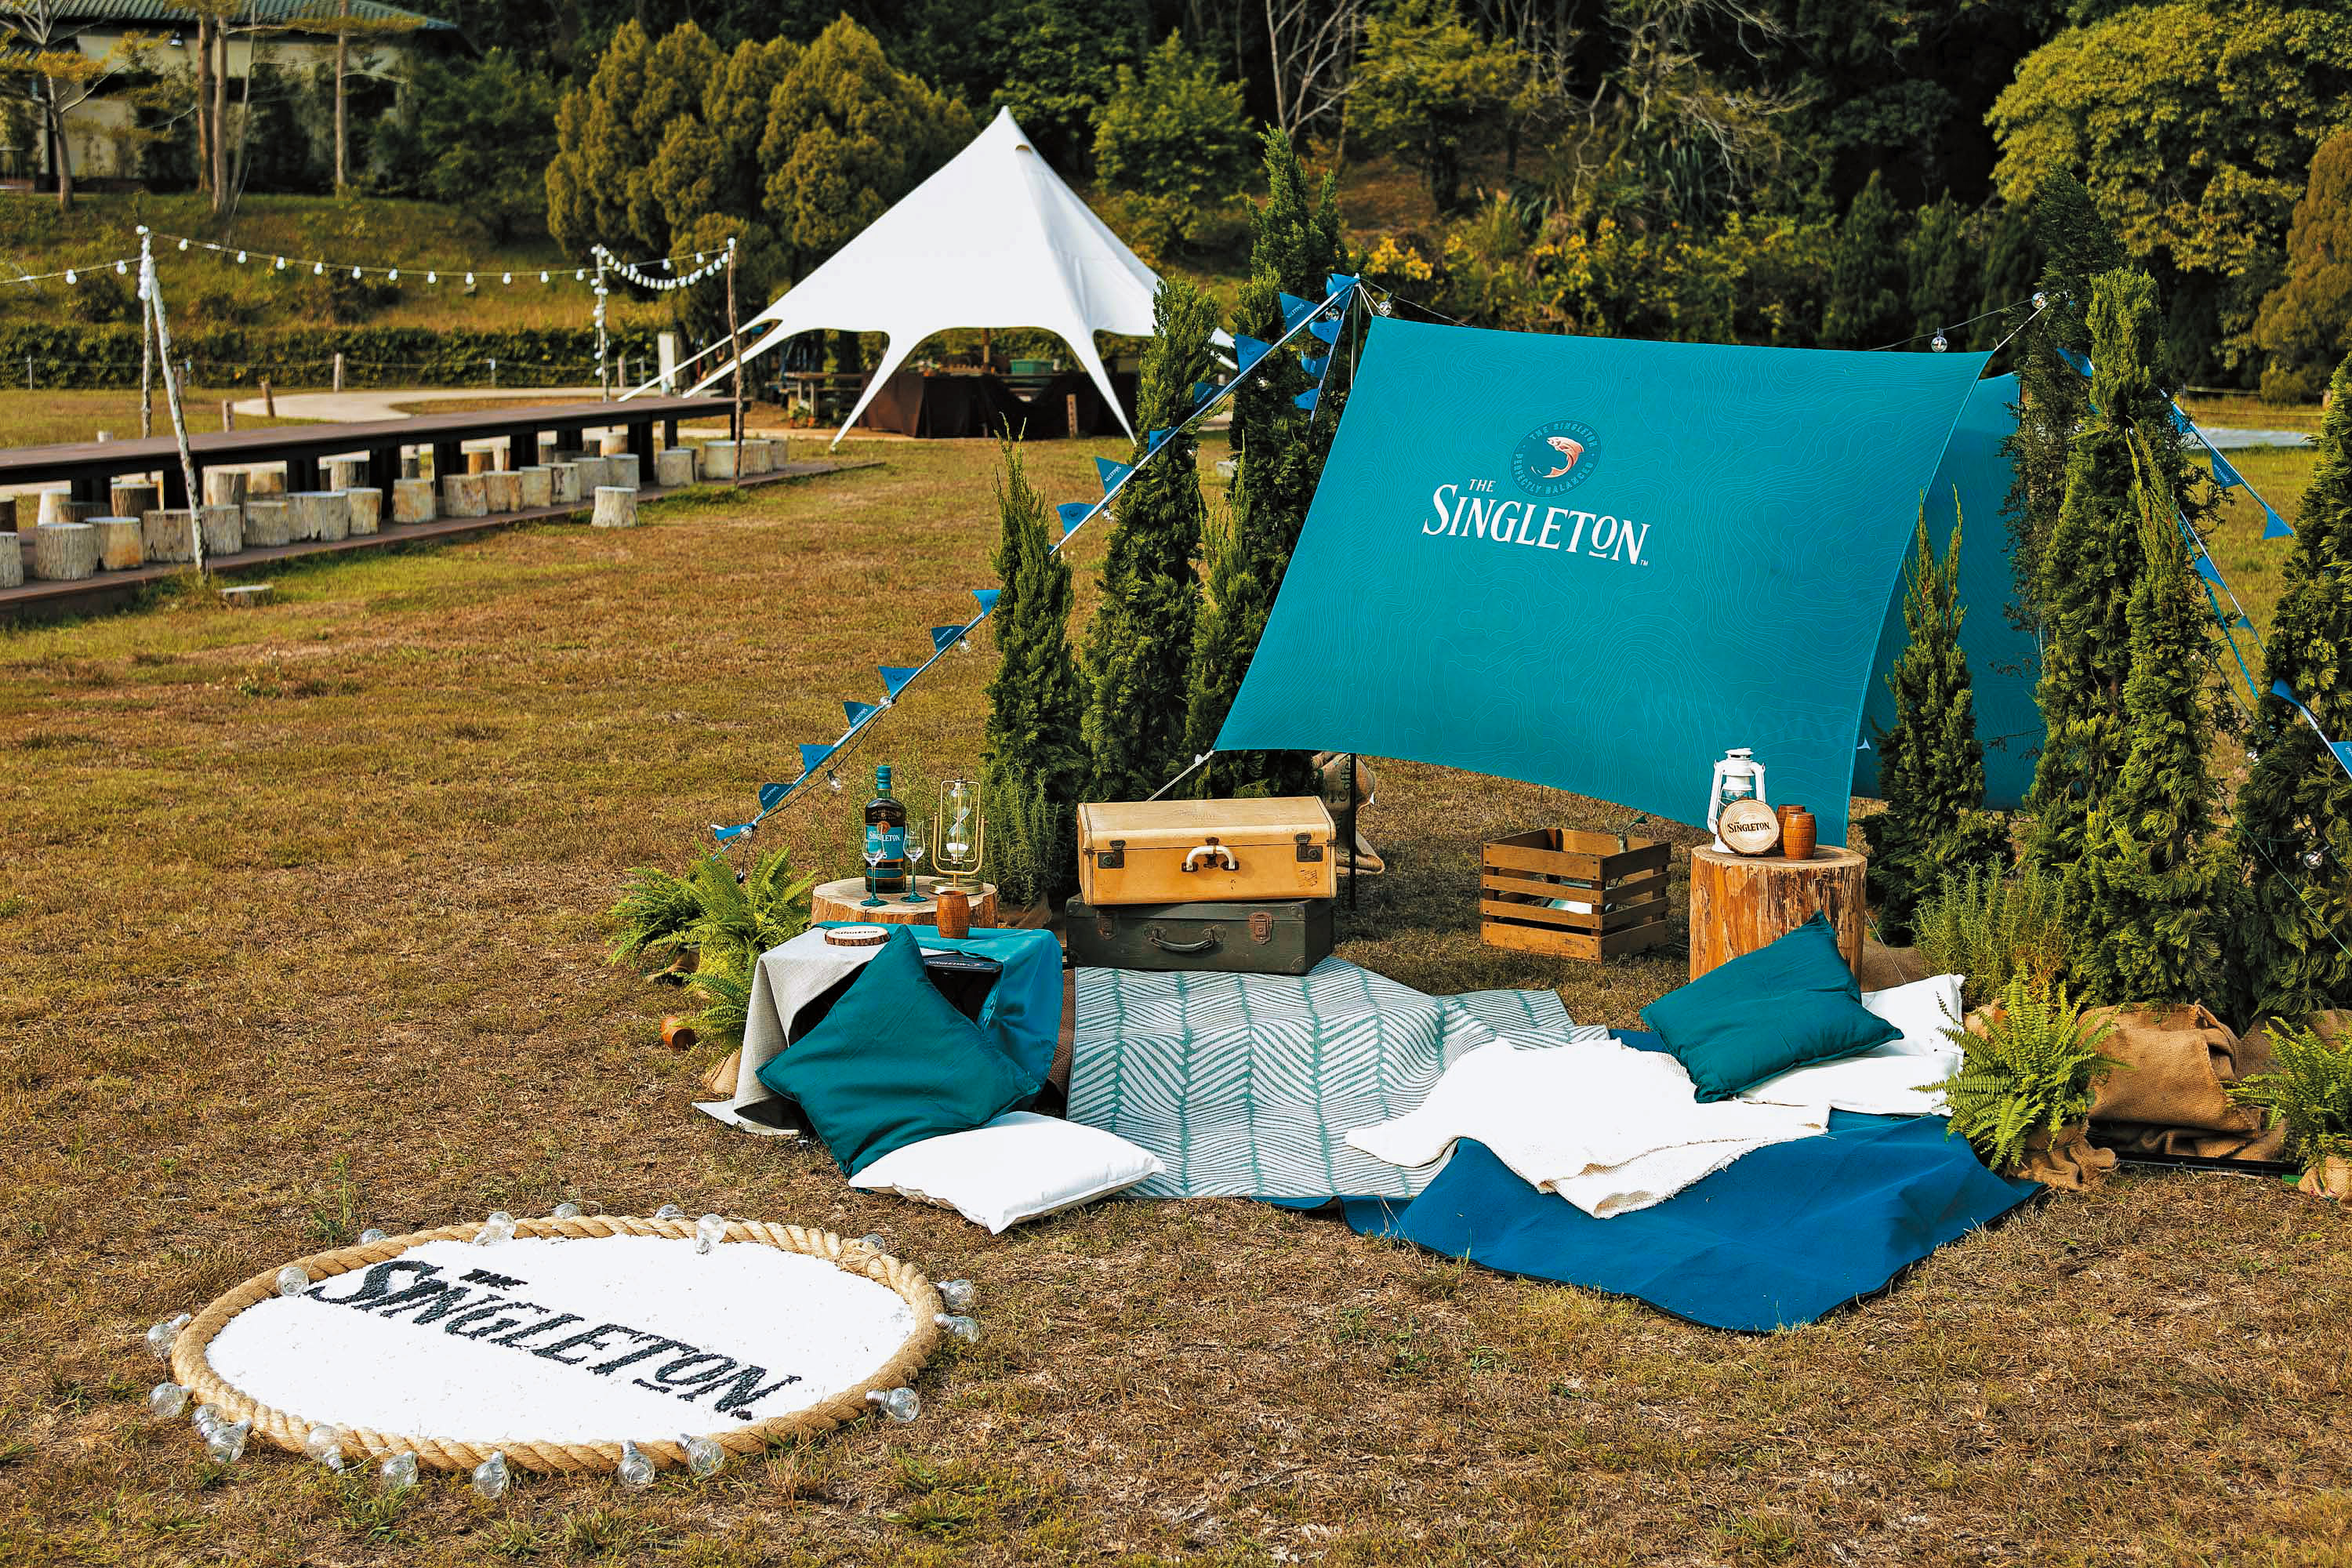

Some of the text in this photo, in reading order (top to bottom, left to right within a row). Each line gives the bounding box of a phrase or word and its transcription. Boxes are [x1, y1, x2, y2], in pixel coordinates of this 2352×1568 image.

[1530, 426, 1549, 439] THE
[1468, 478, 1496, 492] THE
[1514, 453, 1593, 494] PERFECTLY BALANCED
[1421, 484, 1651, 564] SINGLETON
[1727, 822, 1770, 833] SINGLETON
[303, 1261, 802, 1412] SINGLETON
